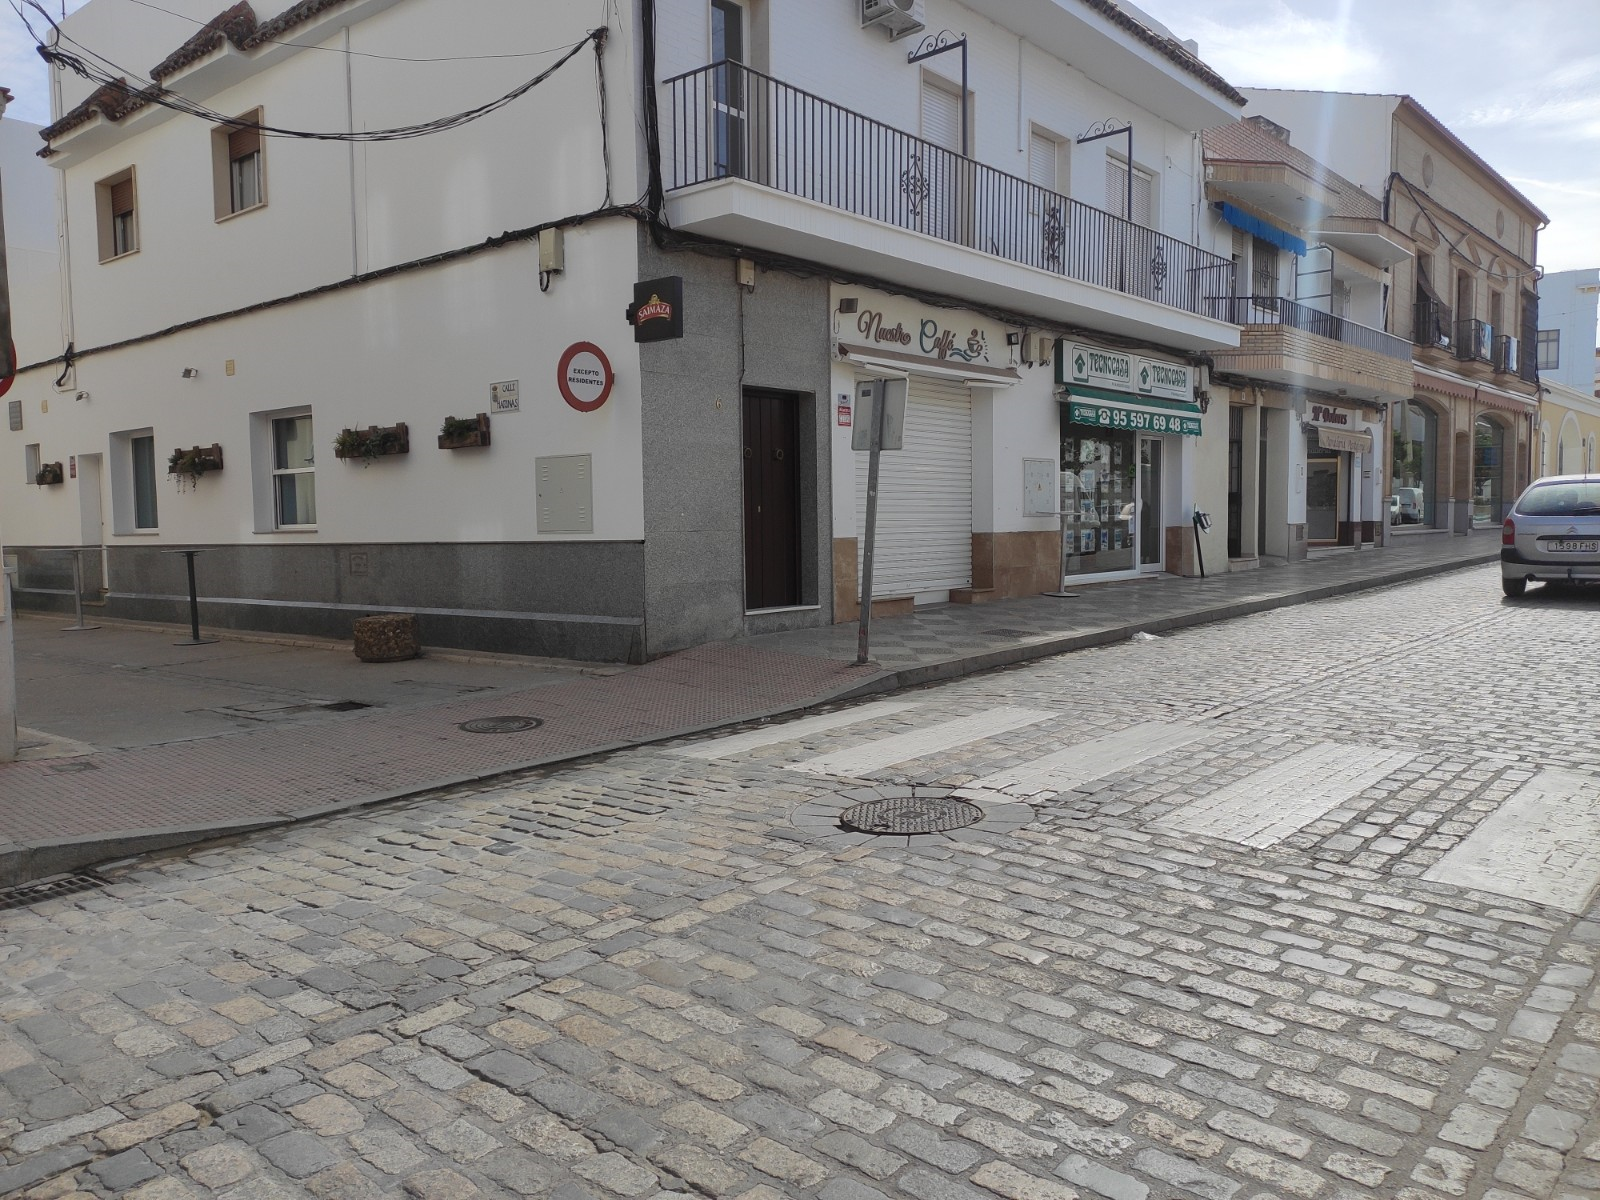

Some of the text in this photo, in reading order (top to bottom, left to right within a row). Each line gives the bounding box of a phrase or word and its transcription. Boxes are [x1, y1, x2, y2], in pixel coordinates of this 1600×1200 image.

[638, 305, 670, 318] SAIMAZA
[857, 310, 911, 345] Nuestro
[573, 368, 599, 377] EXCEPTO
[1089, 352, 1129, 378] TECNOCASA
[568, 377, 604, 386] RESIDENTES
[1152, 365, 1186, 388] TECNOCASA
[1113, 410, 1127, 426] 95
[1130, 412, 1150, 428] 597
[1153, 416, 1166, 430] 69
[1169, 418, 1181, 432] 48
[1580, 542, 1597, 550] FHS
